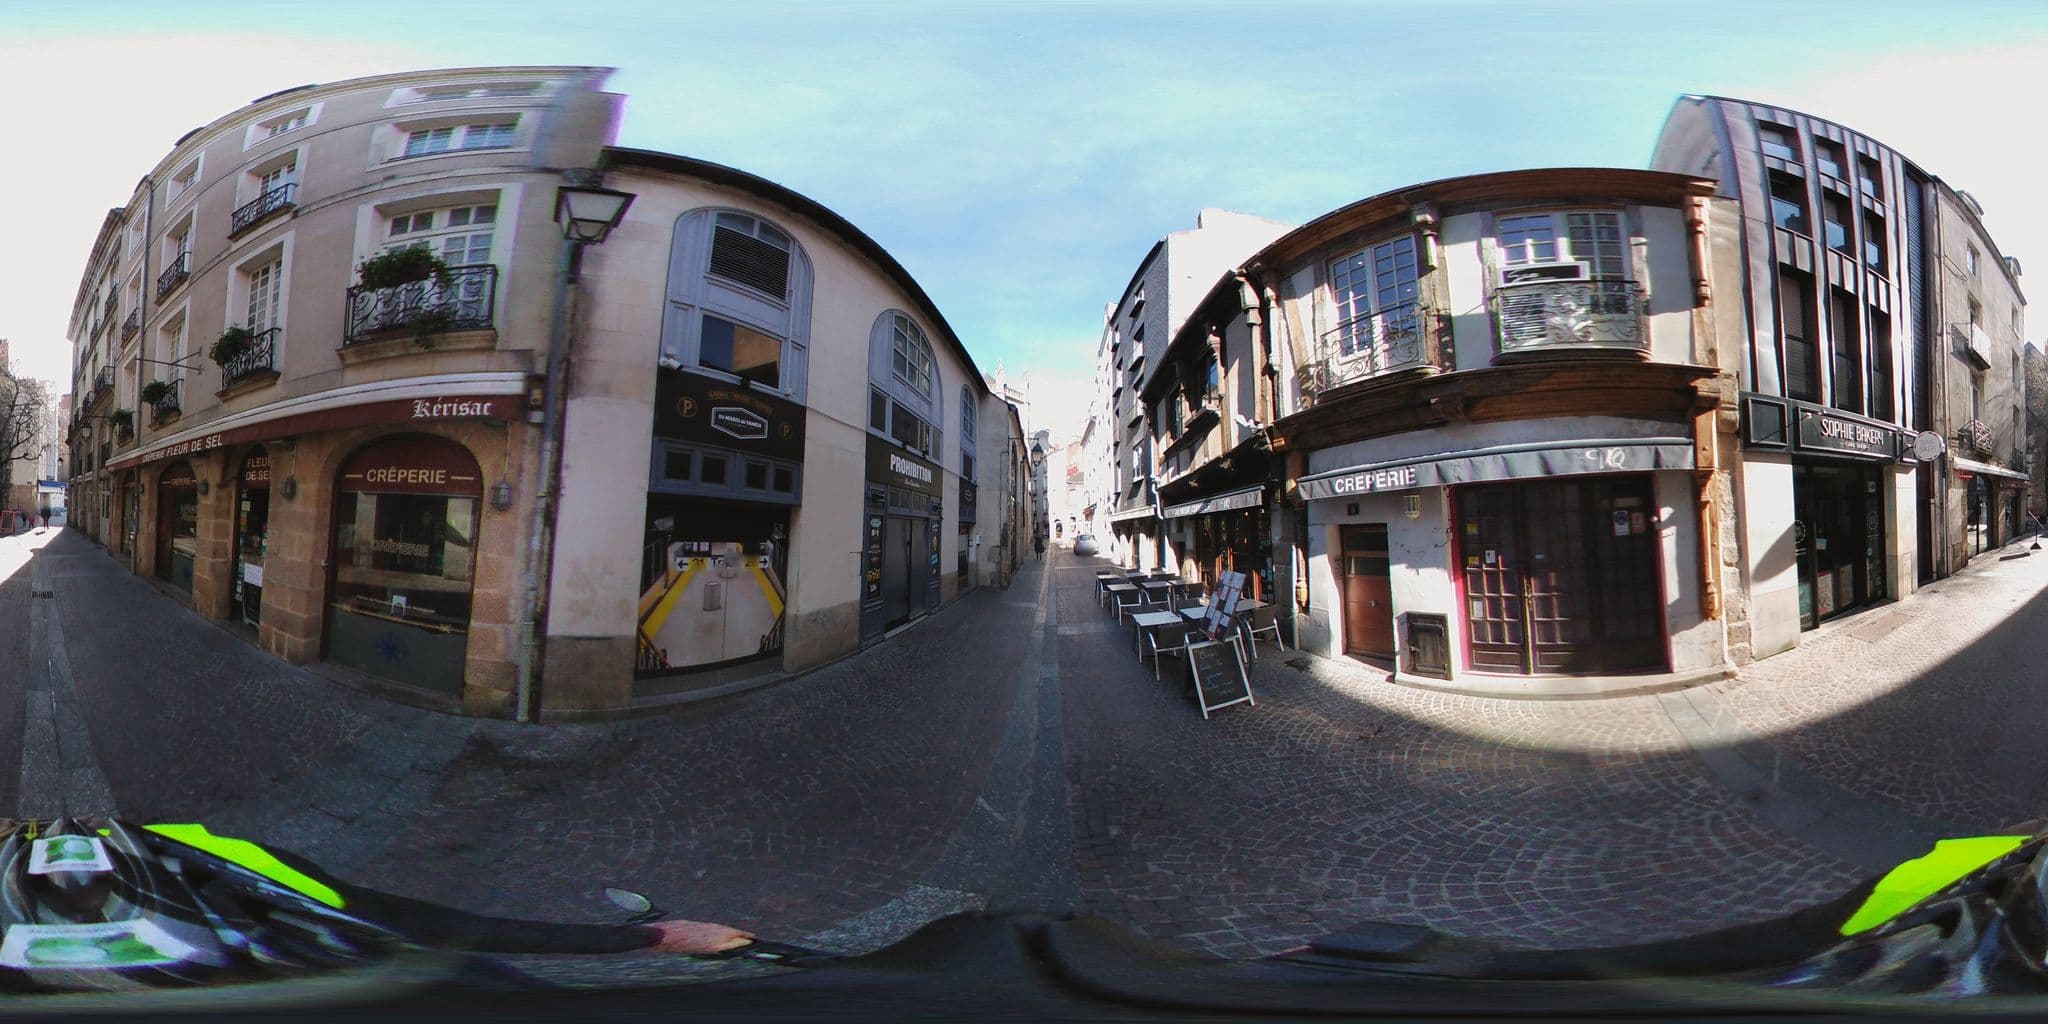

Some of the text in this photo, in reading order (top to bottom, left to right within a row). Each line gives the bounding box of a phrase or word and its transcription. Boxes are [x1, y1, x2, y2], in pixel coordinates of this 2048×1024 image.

[411, 396, 493, 419] Kérisac
[1821, 419, 1884, 446] SOPHIE BAKERY
[166, 442, 189, 457] FLEUR
[190, 439, 202, 452] DE
[205, 434, 222, 449] SEL
[245, 470, 257, 481] DE
[366, 466, 447, 484] CRÊPERIE
[890, 453, 932, 483] PROHIBITION
[1335, 468, 1416, 493] CREPERIE
